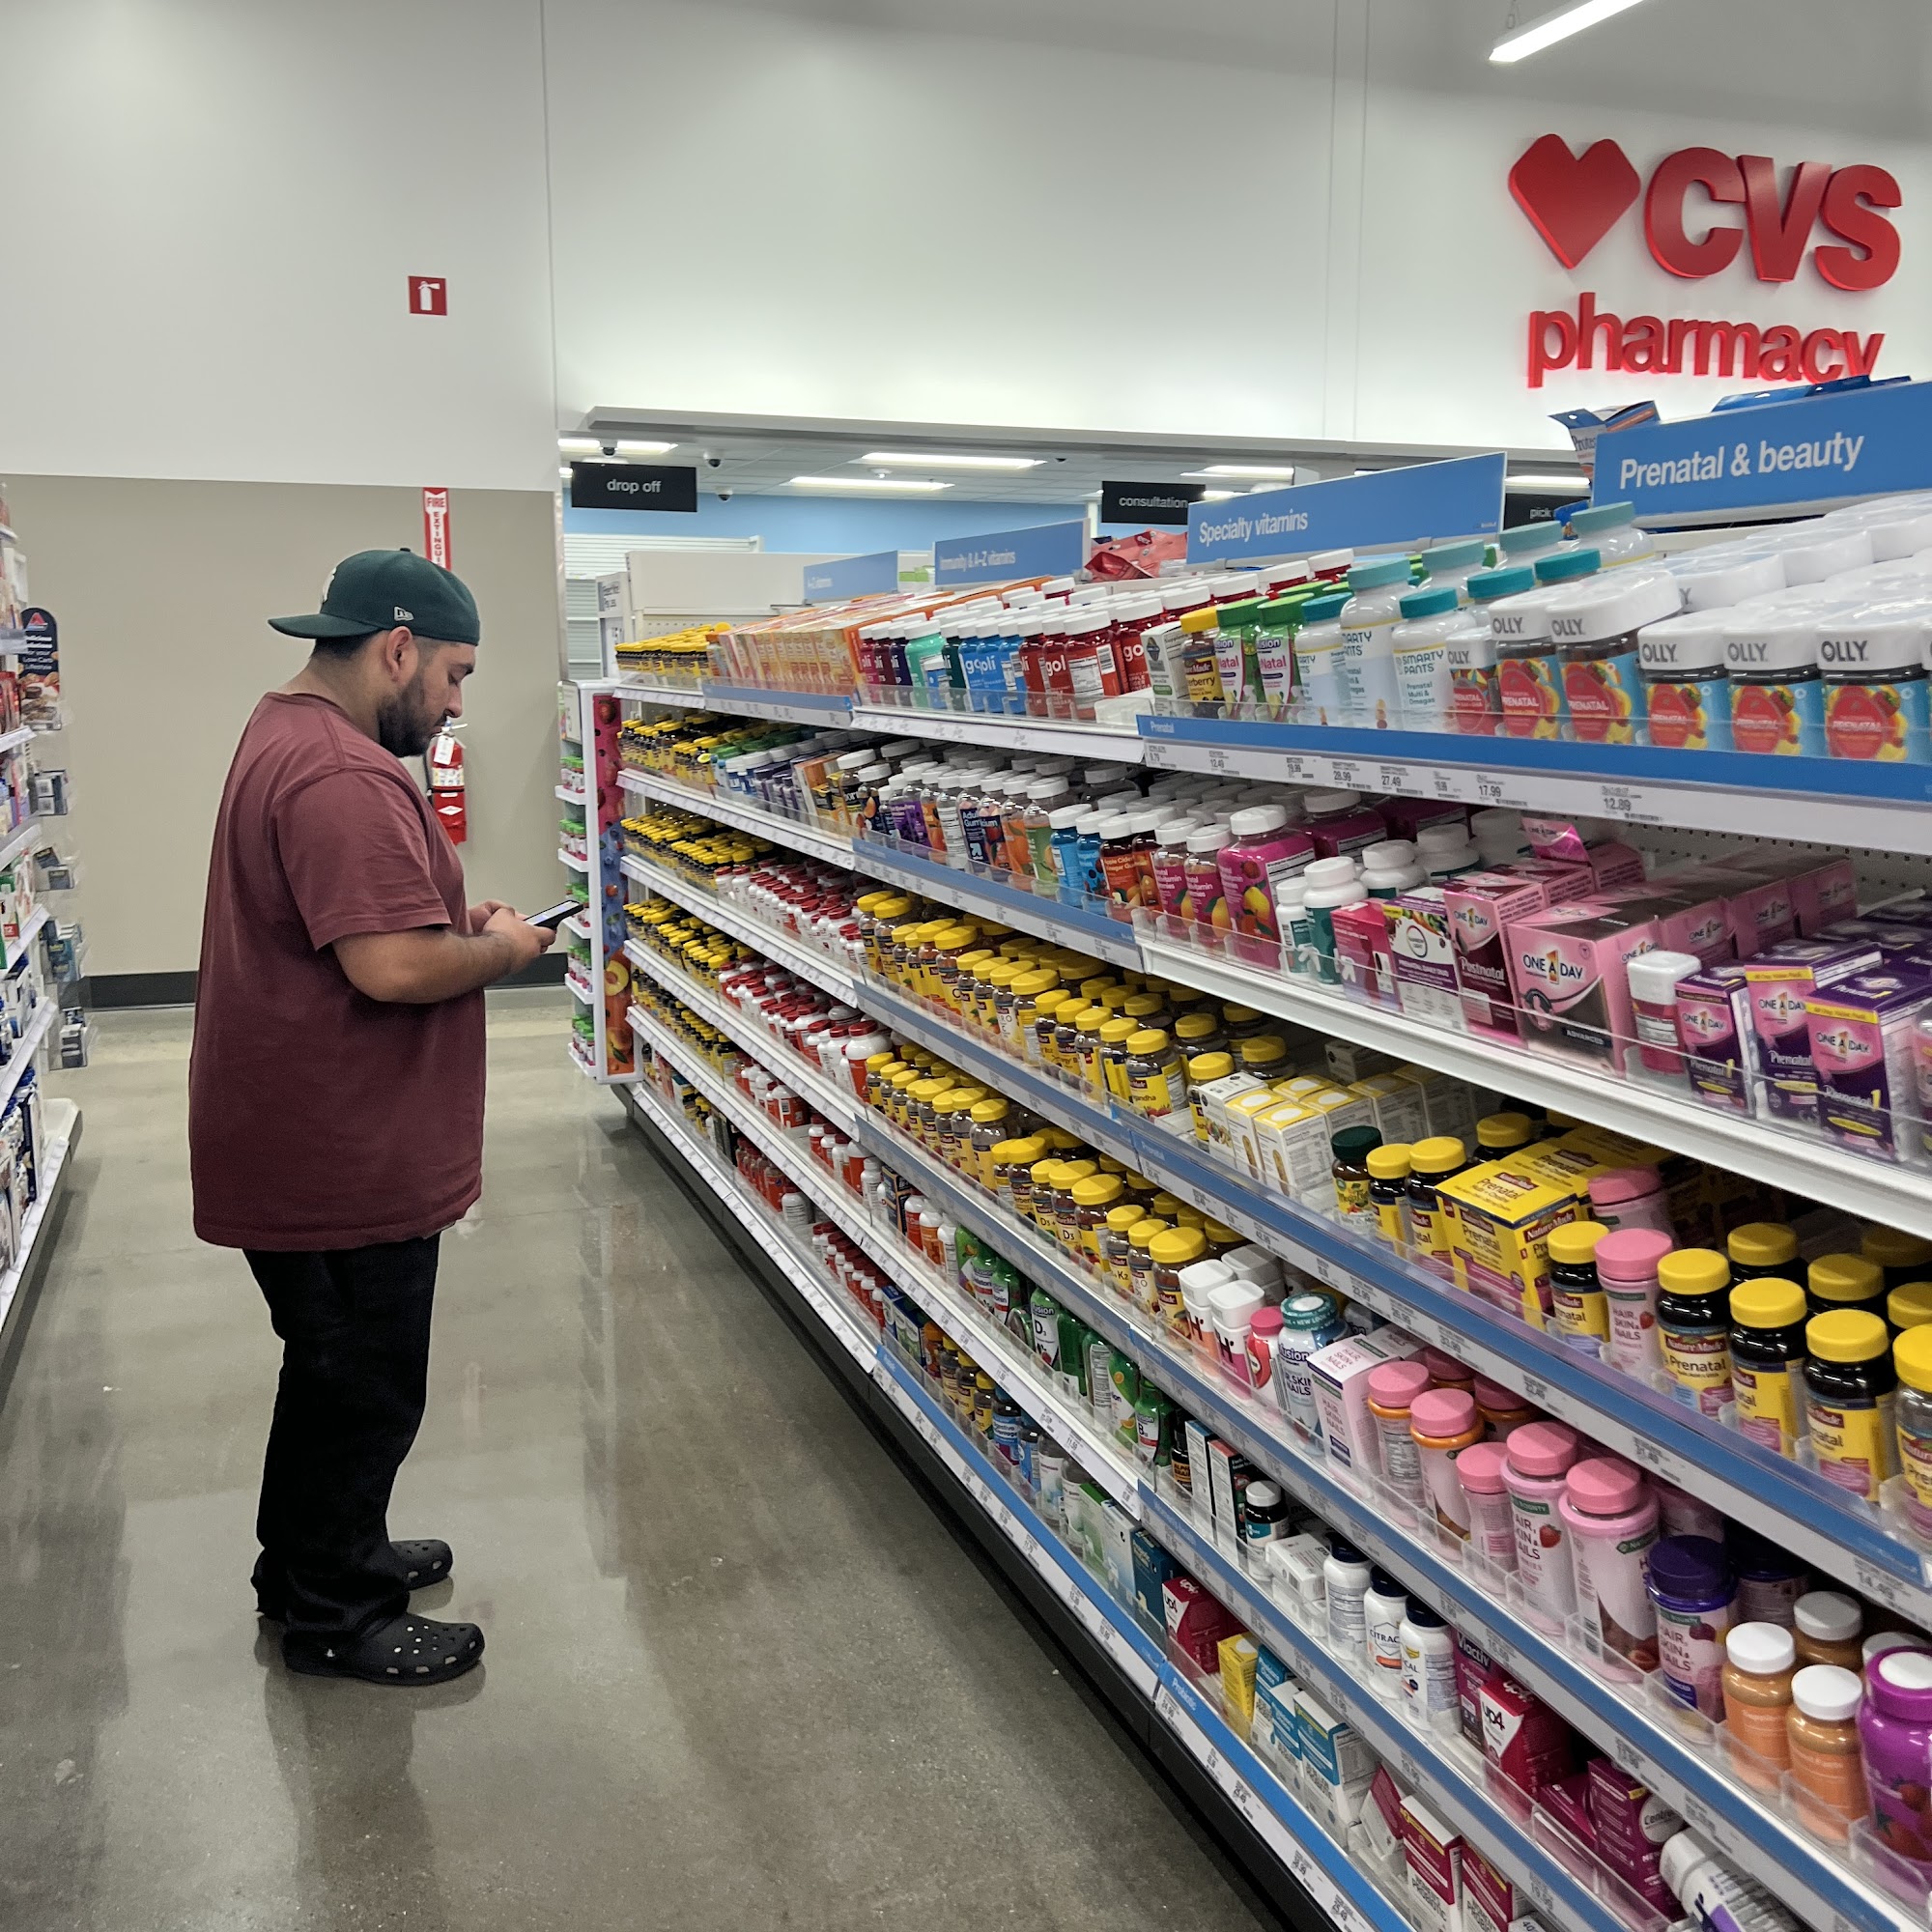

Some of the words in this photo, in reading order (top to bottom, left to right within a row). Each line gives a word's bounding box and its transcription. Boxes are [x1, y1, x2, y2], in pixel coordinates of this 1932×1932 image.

[1646, 146, 1902, 291] CVS
[1527, 292, 1886, 388] pharmacy
[1620, 446, 1724, 490] Prenatal
[1730, 442, 1751, 476] &
[1758, 432, 1865, 473] beauty
[607, 479, 639, 495] drop
[641, 480, 662, 493] off
[427, 497, 445, 507] FIRE
[1119, 496, 1188, 509] consultation
[1530, 507, 1551, 519] pick
[1199, 517, 1253, 548] Specialty
[1256, 509, 1308, 532] vitamins
[1492, 616, 1524, 633] OLLY
[1551, 618, 1586, 636] OLLY
[1402, 650, 1444, 666] SMARTY
[1448, 650, 1470, 665] OLLY
[1642, 643, 1678, 663] OLLY
[1727, 642, 1768, 663] OLLY
[1821, 640, 1868, 662] OLLY
[1404, 663, 1435, 675] PANTS
[1381, 776, 1401, 787] 27.49
[1478, 785, 1501, 797] 17.99
[1454, 910, 1467, 922] ONE
[1474, 915, 1488, 926] DAY
[1461, 956, 1504, 980] Postnatal
[1522, 954, 1546, 972] ONE
[1548, 963, 1557, 974] A
[1559, 964, 1583, 980] DAY
[1758, 999, 1776, 1009] ONE
[1682, 1013, 1699, 1024] ONE
[1708, 1019, 1724, 1030] DAY
[1816, 1032, 1836, 1046] ONE
[1848, 1039, 1871, 1054] DAY
[1477, 1179, 1523, 1200] Prenatal
[1463, 1224, 1501, 1247] Prenatal
[1613, 1308, 1637, 1320] HAIR,
[1615, 1328, 1640, 1340] NAILS
[1666, 1336, 1724, 1353] NatureMade
[1669, 1355, 1726, 1372] Prenatal
[1516, 1518, 1537, 1533] AIR,
[1518, 1545, 1541, 1560] AILS
[1369, 1628, 1401, 1644] CITRAC
[1663, 1629, 1689, 1644] AIR,
[1457, 1632, 1491, 1667] Viactiv
[1663, 1653, 1691, 1671] AILS
[1171, 1677, 1197, 1711] Probiotic
[1481, 1700, 1506, 1731] up4
[1643, 1808, 1676, 1827] Centr
